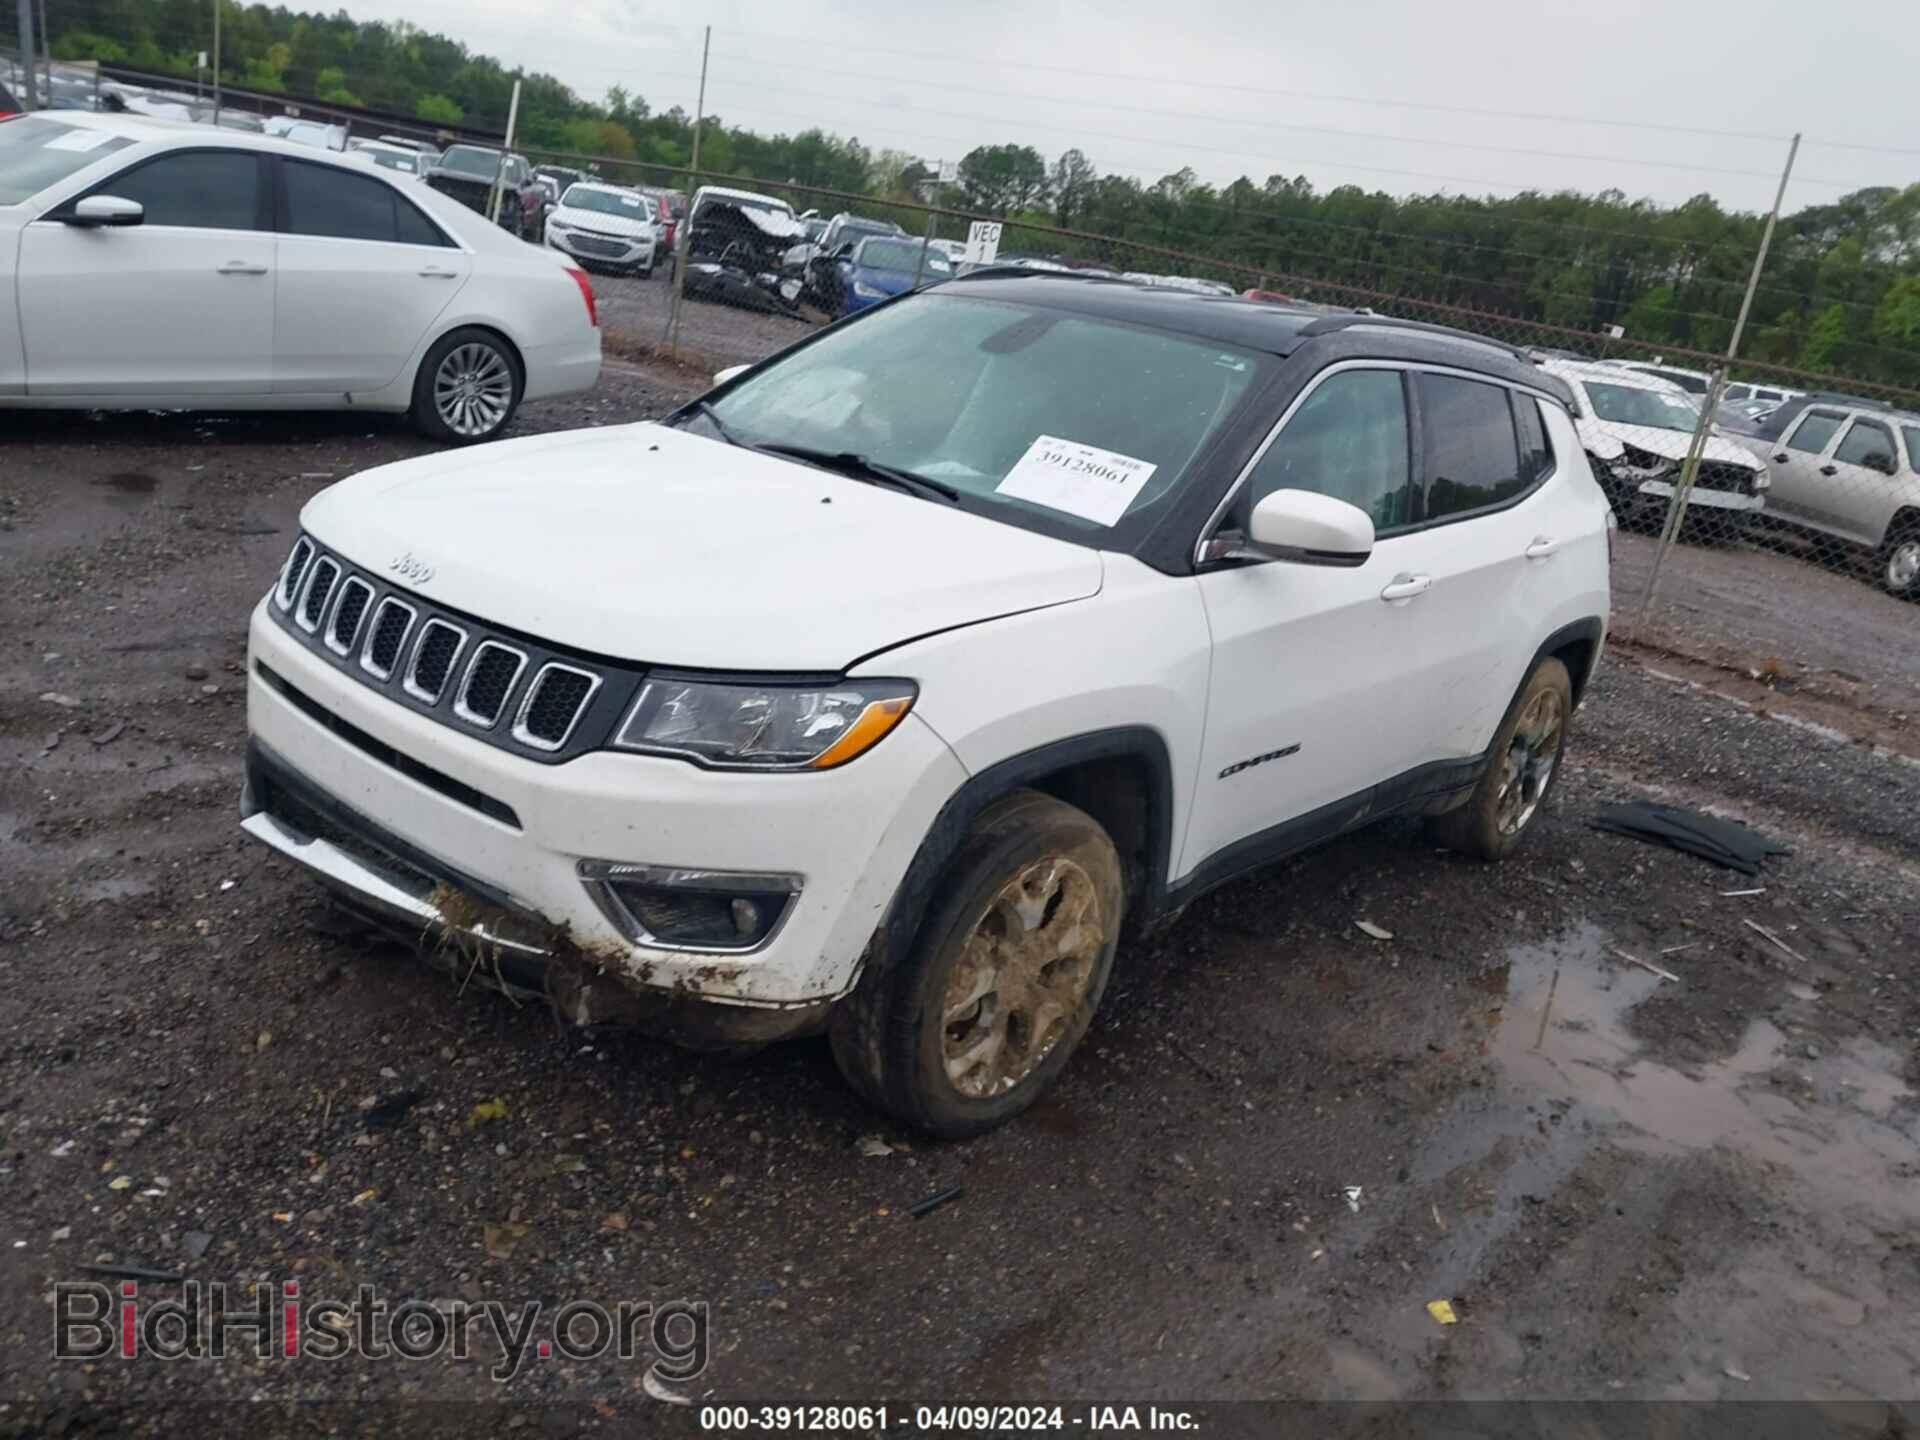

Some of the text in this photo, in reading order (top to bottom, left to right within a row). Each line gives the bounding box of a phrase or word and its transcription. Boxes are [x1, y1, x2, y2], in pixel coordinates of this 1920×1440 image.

[973, 224, 1000, 242] VEC
[1036, 450, 1130, 484] 39128061
[389, 552, 436, 586] Jeep
